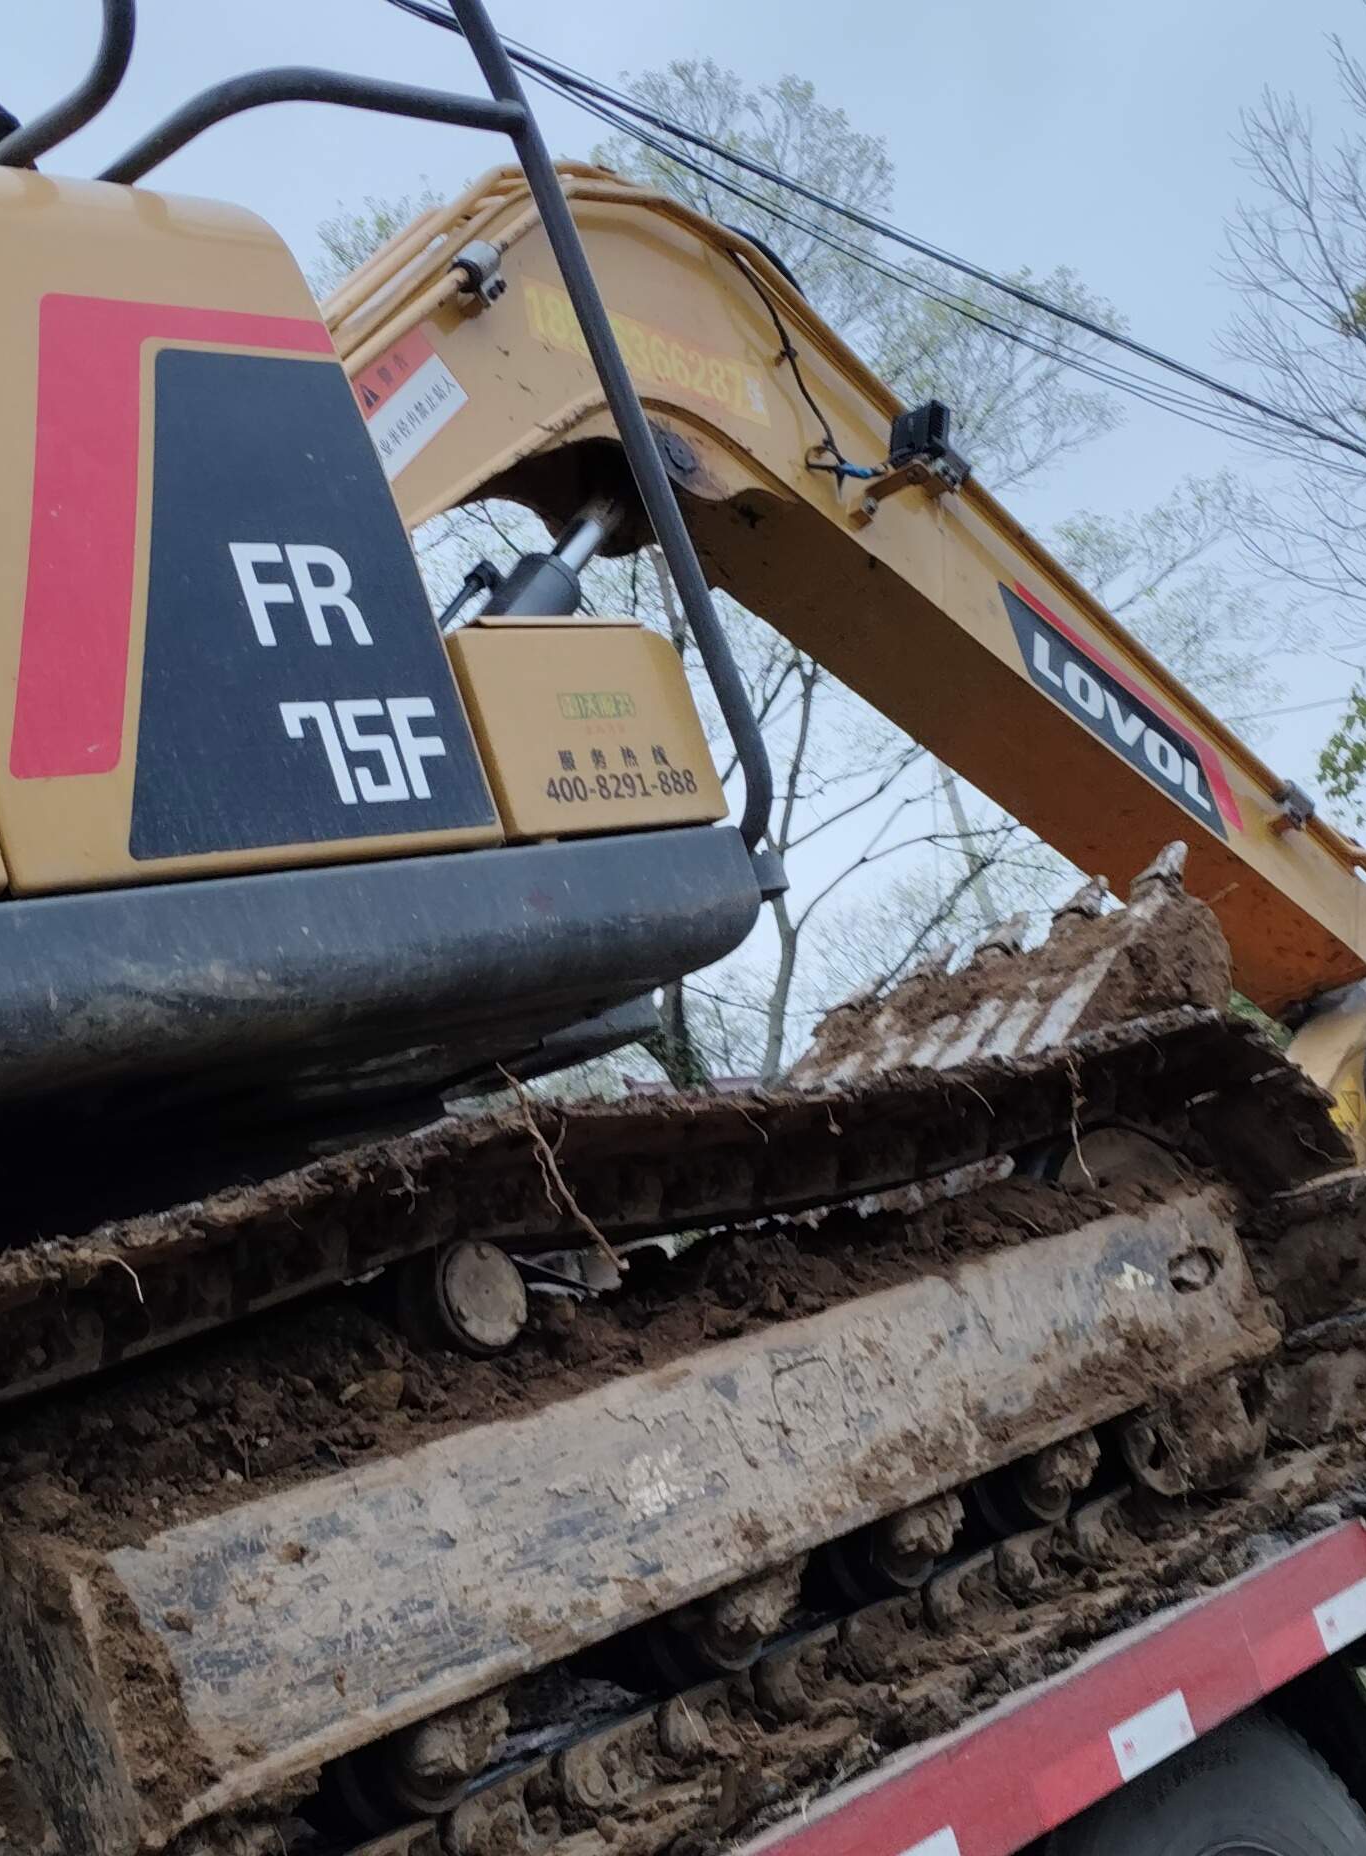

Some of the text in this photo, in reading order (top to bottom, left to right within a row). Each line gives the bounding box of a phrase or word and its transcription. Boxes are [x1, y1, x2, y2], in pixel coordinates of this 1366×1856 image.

[228, 541, 374, 647] FR
[278, 696, 447, 804] 75F
[1033, 631, 1212, 812] LOVOL
[546, 768, 698, 803] 400-8291-888
